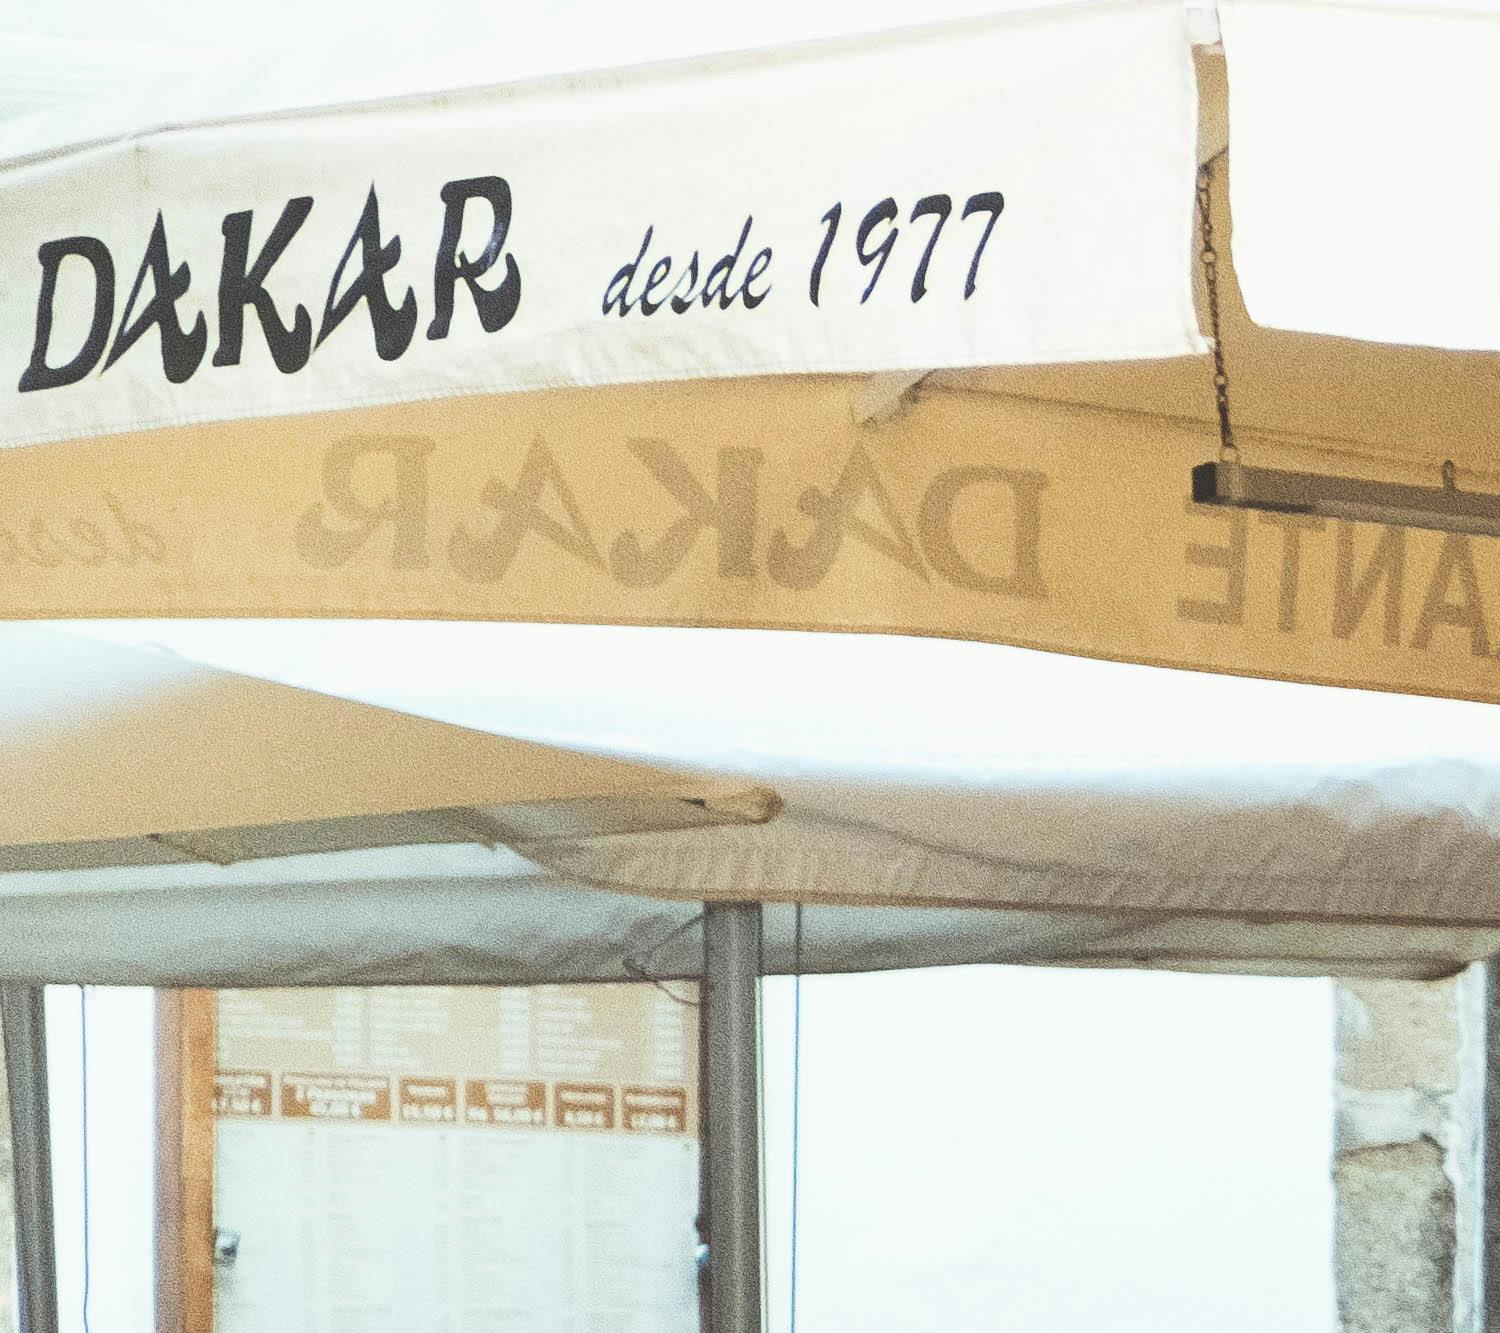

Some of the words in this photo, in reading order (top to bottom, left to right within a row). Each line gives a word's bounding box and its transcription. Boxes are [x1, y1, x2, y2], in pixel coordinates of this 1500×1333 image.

[19, 177, 522, 392] DAKAR
[602, 215, 773, 317] desde
[809, 191, 1004, 306] 1977
